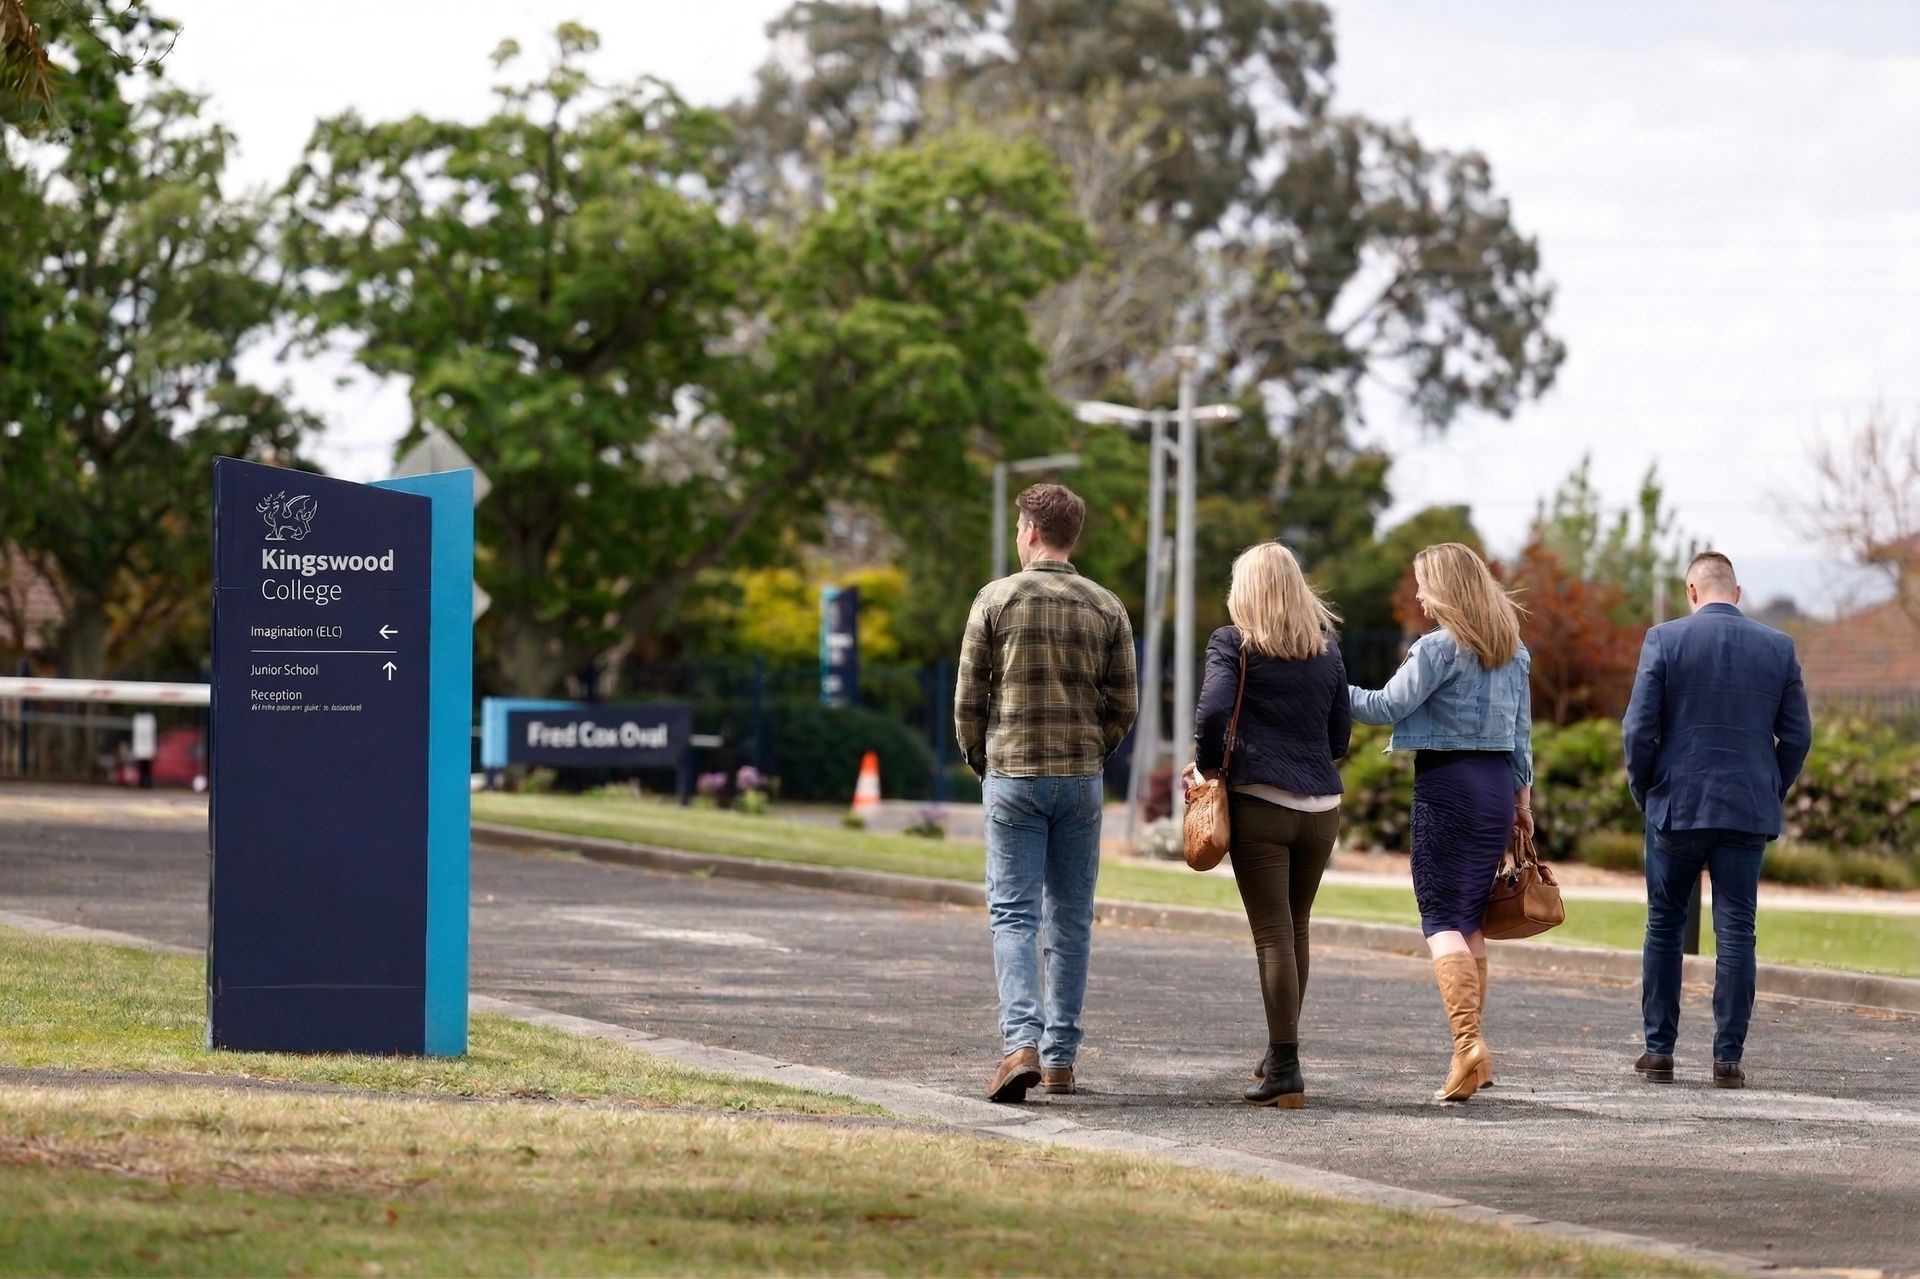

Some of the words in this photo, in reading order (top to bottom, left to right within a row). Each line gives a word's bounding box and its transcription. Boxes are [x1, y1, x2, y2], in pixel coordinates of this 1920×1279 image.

[261, 548, 394, 577] Kingswood
[261, 579, 342, 606] College
[250, 625, 314, 640] Imagination
[315, 625, 343, 639] (ELC)
[250, 664, 283, 676] Junior
[284, 664, 319, 676] School
[250, 689, 303, 703] Reception
[527, 721, 577, 748] Fred
[619, 721, 668, 748] Oval
